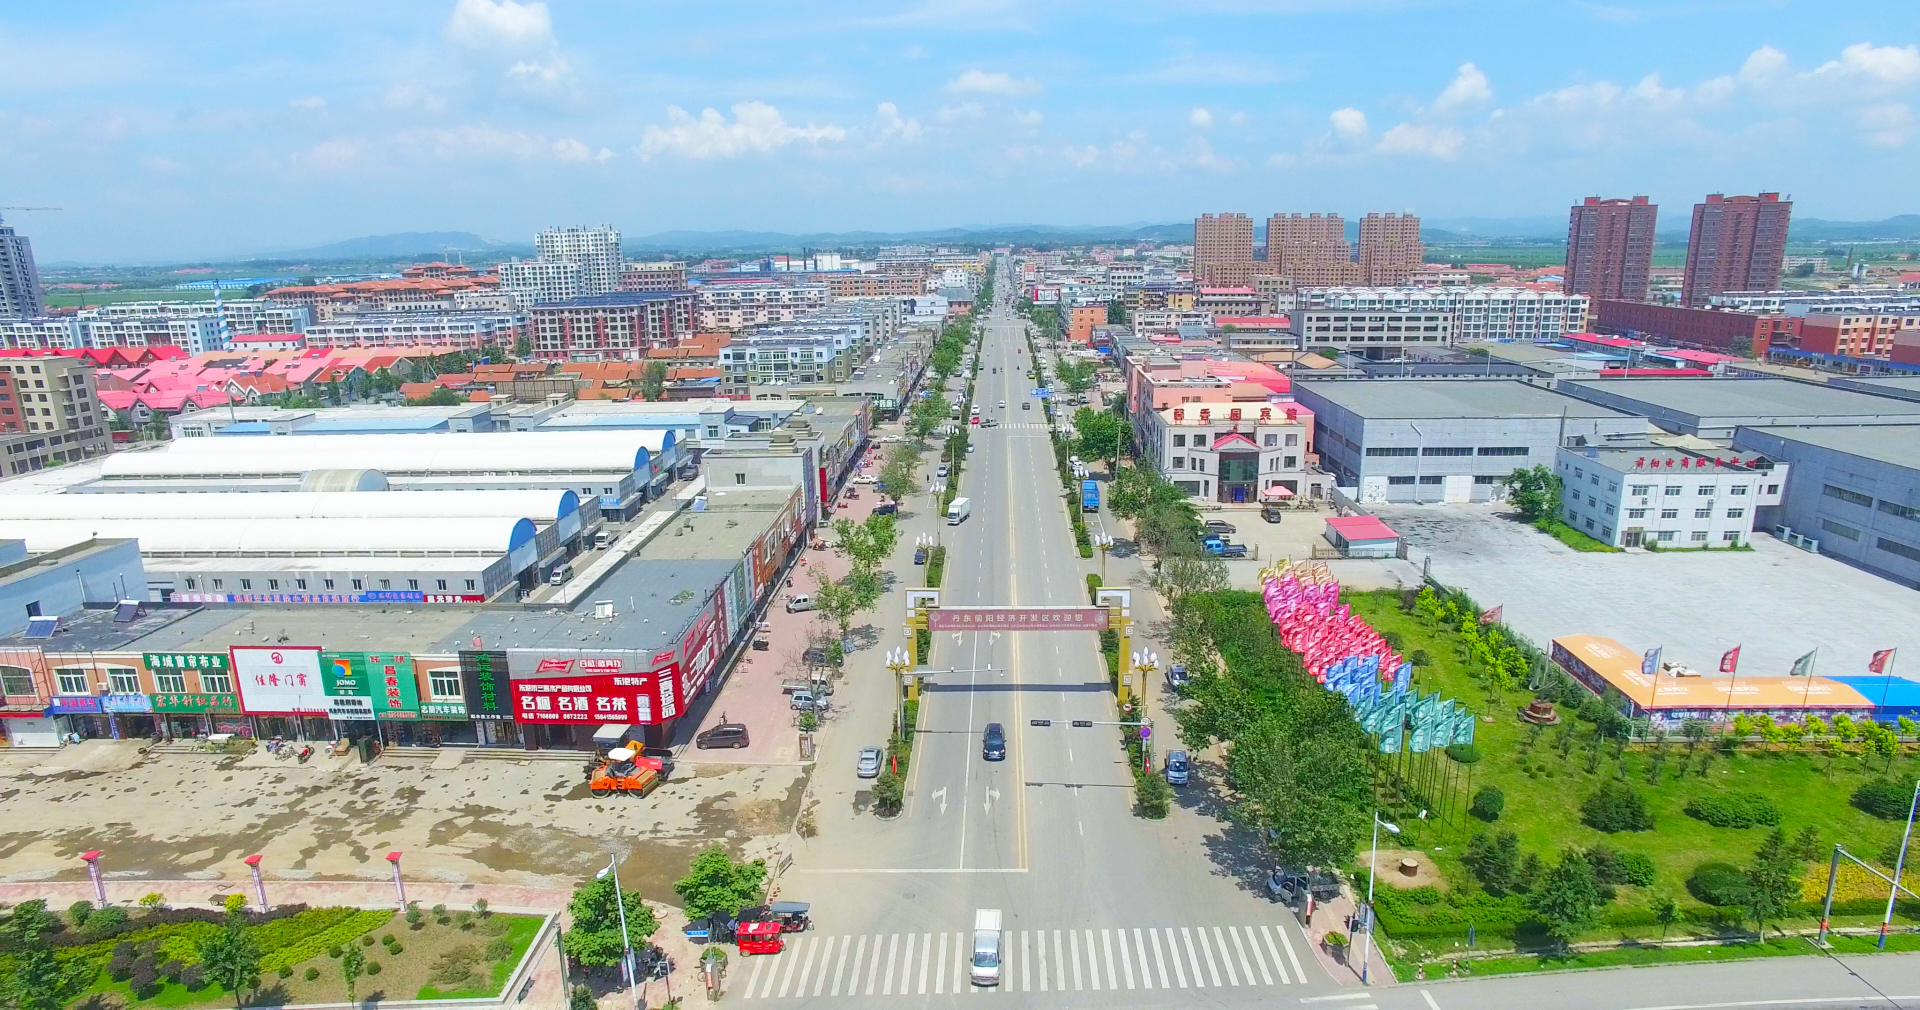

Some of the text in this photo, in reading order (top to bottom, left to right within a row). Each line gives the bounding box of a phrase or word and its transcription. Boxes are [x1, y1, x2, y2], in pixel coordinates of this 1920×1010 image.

[1634, 456, 1758, 468] 前阳电商服务中心
[952, 613, 1083, 622] 丹东前阳经济开发区欢迎您
[149, 654, 222, 668] 海城窗帘布业
[255, 673, 308, 687] 佳隆门窗
[336, 679, 356, 687] JOMO
[558, 696, 589, 711] 名酒
[596, 697, 627, 711] 名茶
